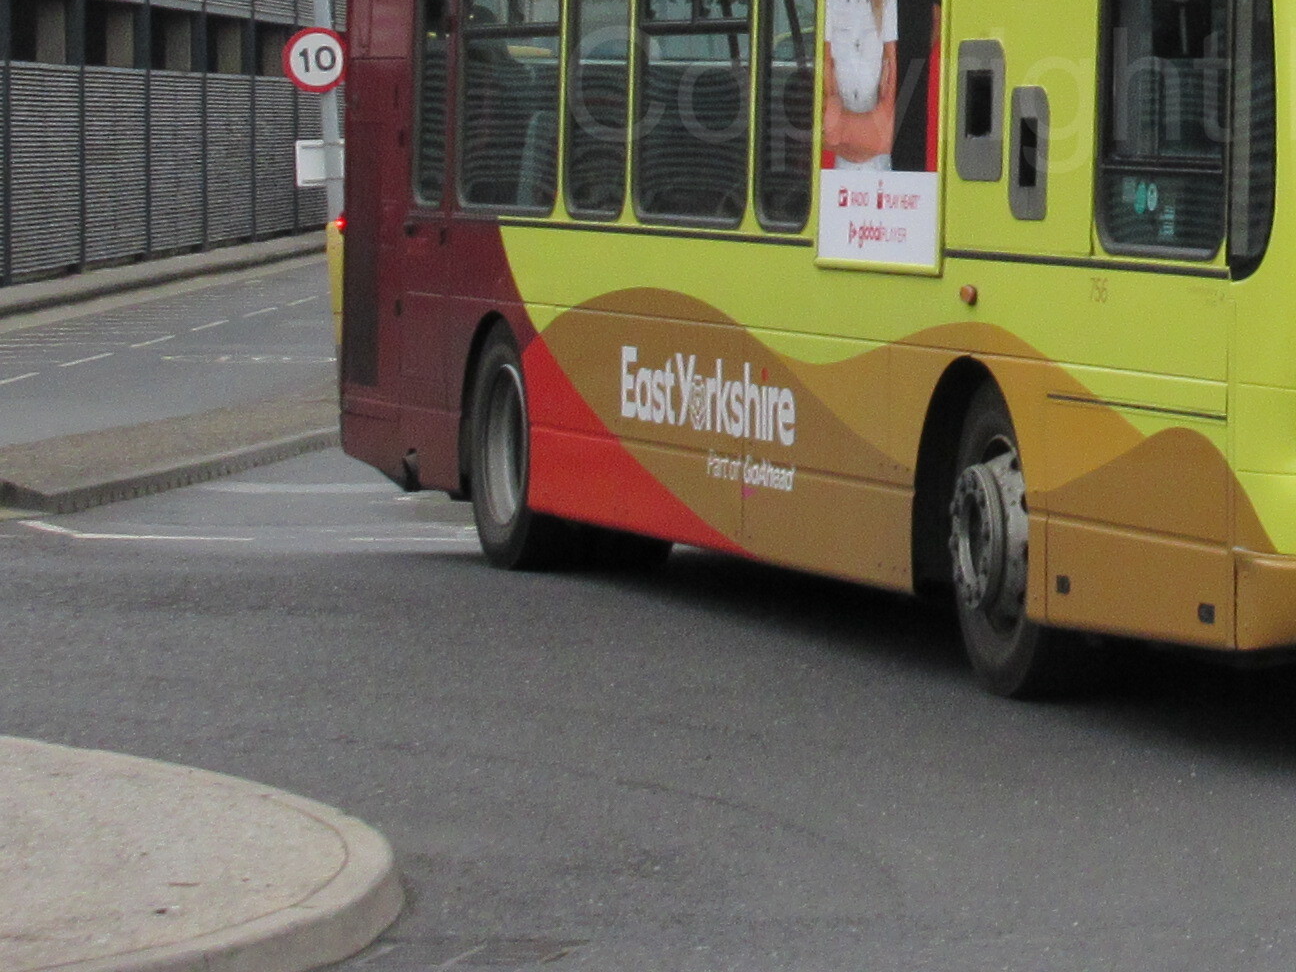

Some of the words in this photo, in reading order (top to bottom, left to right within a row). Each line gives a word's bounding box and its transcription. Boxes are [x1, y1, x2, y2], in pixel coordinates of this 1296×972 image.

[299, 45, 337, 74] 10
[621, 345, 676, 425] East
[675, 352, 796, 447] Yorkshire
